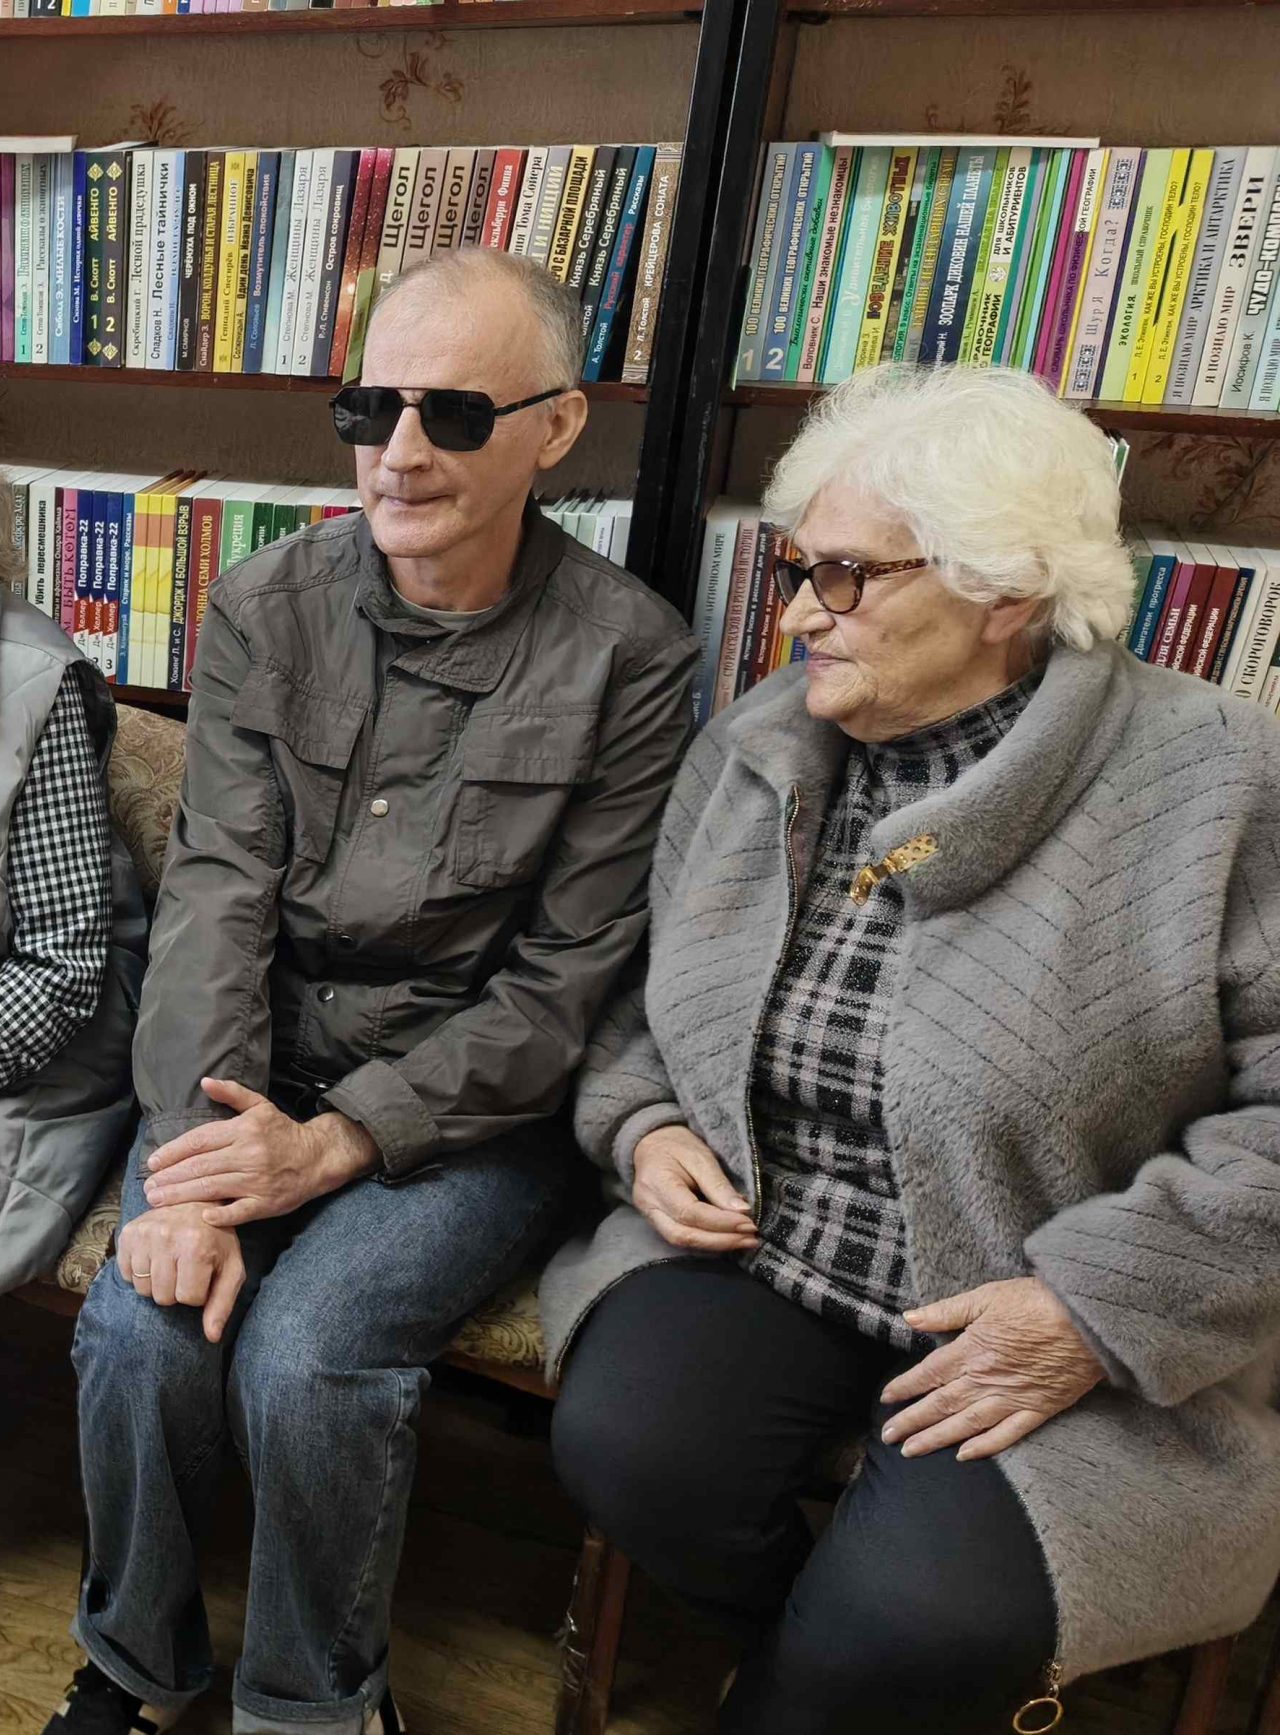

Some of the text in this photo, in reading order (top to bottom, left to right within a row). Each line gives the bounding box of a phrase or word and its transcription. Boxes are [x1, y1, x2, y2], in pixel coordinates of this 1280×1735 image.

[89, 188, 99, 288] Скотт АЙВЕНГО
[184, 184, 197, 278] ЧЕРЁМУХА ПОД ОКНОМ
[200, 162, 219, 320] ВОРОН, КОЛДУНЬЯ СТАРАЯ ЛЕСТНИЦА
[236, 168, 254, 299] Один день Ивана Денисовича
[253, 174, 270, 296] Возмутитель спокойствия
[286, 166, 309, 282] Женщины Лазаря
[304, 166, 328, 282] Женщины Лазаря
[331, 184, 344, 234] сокровищ
[383, 166, 410, 248] Щегол
[409, 167, 437, 249] Щегол
[437, 166, 465, 248] Щегол
[516, 156, 543, 230] Тома Сойера
[554, 156, 587, 255] БАЗАРНОЙ ПЛОЩАДИ
[568, 169, 607, 288] Князь Серебряный
[588, 168, 628, 286] Князь Серебряный
[751, 154, 787, 314] ВЕЛИКИХ ГЕОГРАФИЧЕСКИХ ОТКРЫТИЙ
[938, 156, 985, 325] ЗООПАРК ДИКОВИН НАШЕЙ ПЛАНЕТЫ
[996, 166, 1016, 233] ШКОЛЬНИКОВ
[1189, 159, 1235, 312] АРКТИКА АНТАРКТИКА
[1228, 176, 1264, 268] ЗВЕРИ
[106, 187, 118, 332] 2 Скотт АЙВЕНГО
[131, 163, 147, 356] Скребицкий Лесной прадедушка
[150, 162, 169, 359] Сладков Лесные тайнички
[326, 236, 338, 270] Остров
[593, 175, 645, 353] Толстой Рассказы
[638, 175, 670, 330] Толстой КРЕЙЦЕРОВА СОНАТА
[766, 152, 814, 370] 2 100 ВЕЛИКИХ ГЕОГРАФИЧЕСКИХ ОТКРЫТИЙ
[803, 157, 849, 369] Воловник Наши знакомые незнакомцы
[982, 166, 1027, 357] ГЕОГРАФИИ АБИТУРИЕНТОВ
[1094, 219, 1119, 277] Когда?
[1230, 344, 1253, 393] Иосифов
[35, 500, 46, 605] Убить пересмешника
[63, 509, 76, 608] БЫТЬ КОТОМ
[78, 519, 89, 629] Хеллер Поправка-22
[93, 521, 105, 630] Хеллер Поправка-22
[107, 522, 118, 632] Хеллер Поправка-22
[173, 505, 188, 624] ДЖОРДЖ БОЛЬШОЙ ВЗРЫВ
[198, 516, 213, 586] СЕМИ ХОЛМОВ
[734, 568, 747, 603] РУССКОЙ
[725, 616, 742, 661] РАССКАЗОВ
[1134, 567, 1167, 655] Двигатели прогресса
[1163, 608, 1181, 643] СЕМЬИ
[1240, 582, 1280, 684] СКОРОГОВОРОК
[723, 661, 735, 677] СТО
